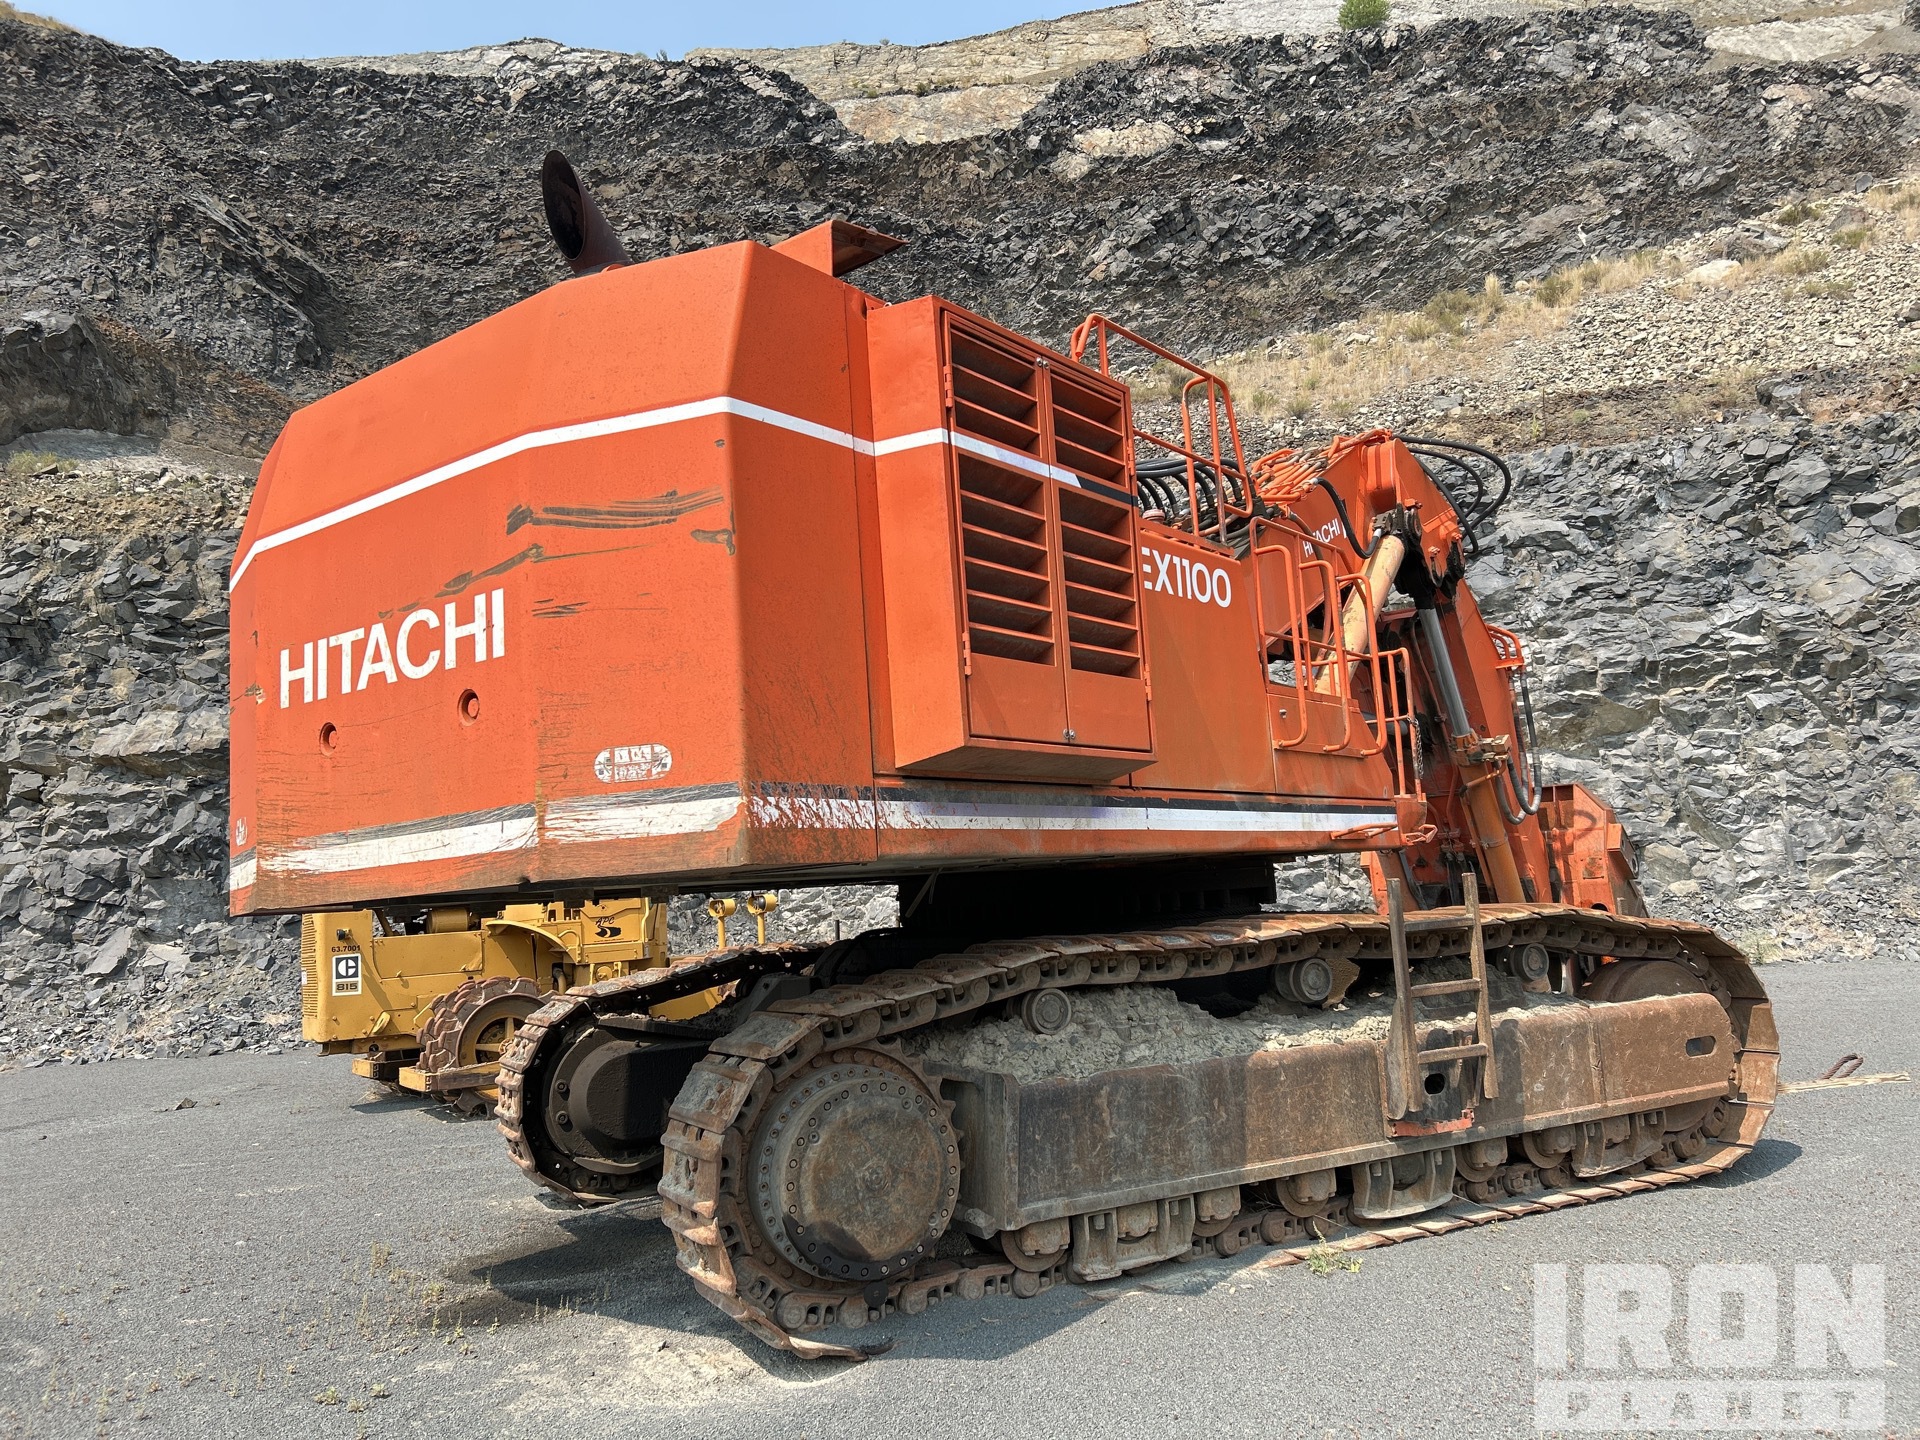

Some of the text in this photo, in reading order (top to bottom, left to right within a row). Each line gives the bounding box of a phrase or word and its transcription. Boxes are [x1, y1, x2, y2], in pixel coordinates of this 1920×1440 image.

[1141, 546, 1232, 608] EX1100
[280, 588, 505, 710] HITACHI
[331, 945, 361, 953] 63.7001
[336, 983, 358, 991] 815
